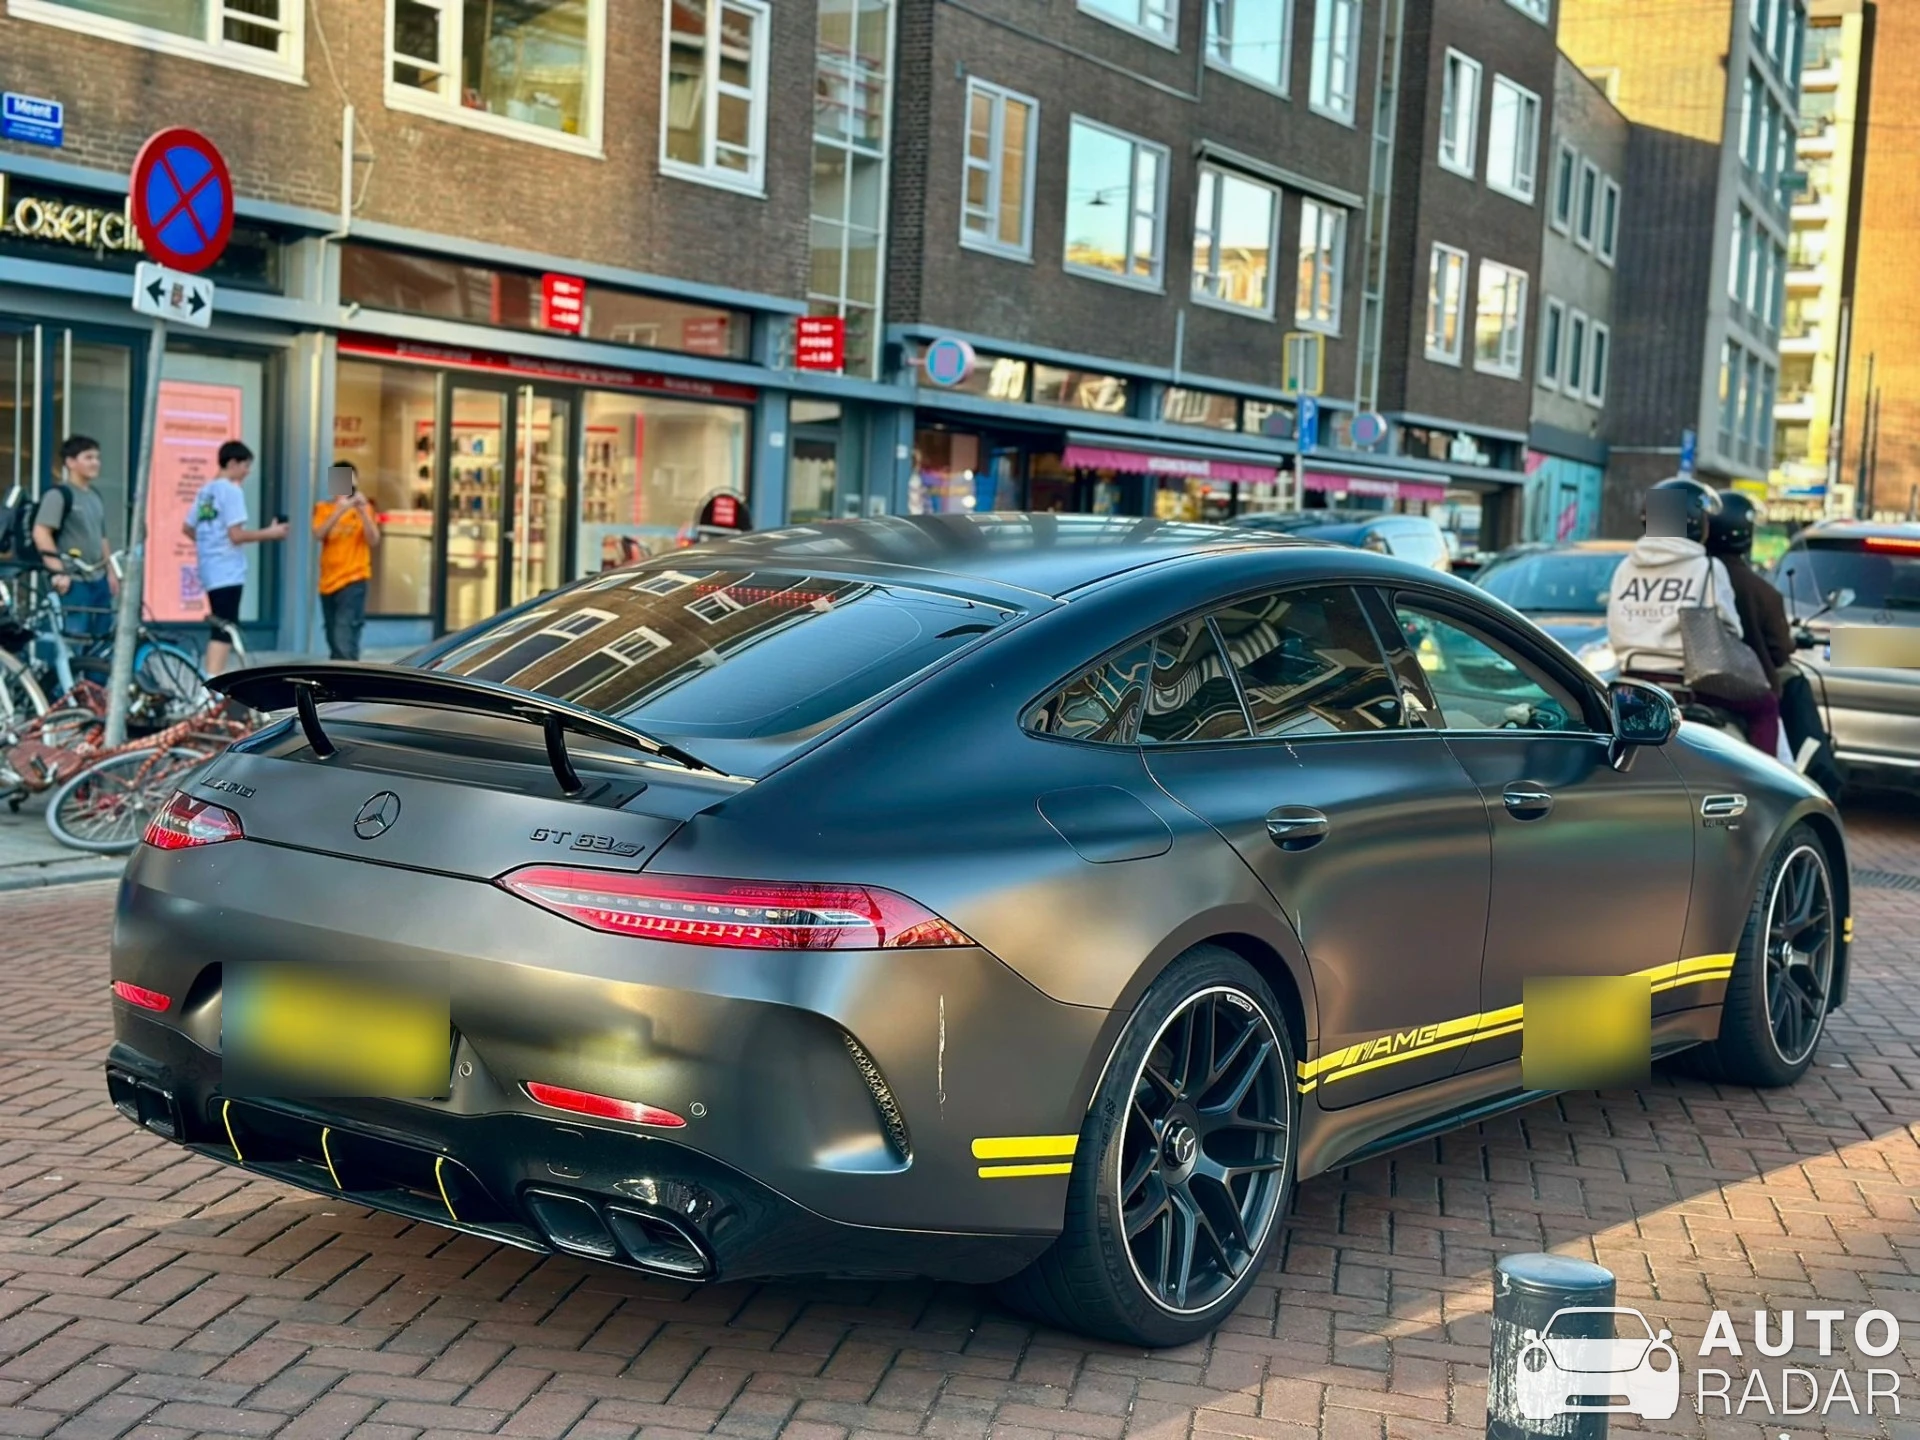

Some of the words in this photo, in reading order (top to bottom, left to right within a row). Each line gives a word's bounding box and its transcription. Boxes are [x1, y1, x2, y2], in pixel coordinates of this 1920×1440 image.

[1618, 577, 1697, 602] AYBL
[212, 779, 256, 798] AMG
[529, 828, 572, 844] GT
[1369, 1024, 1440, 1060] AMG
